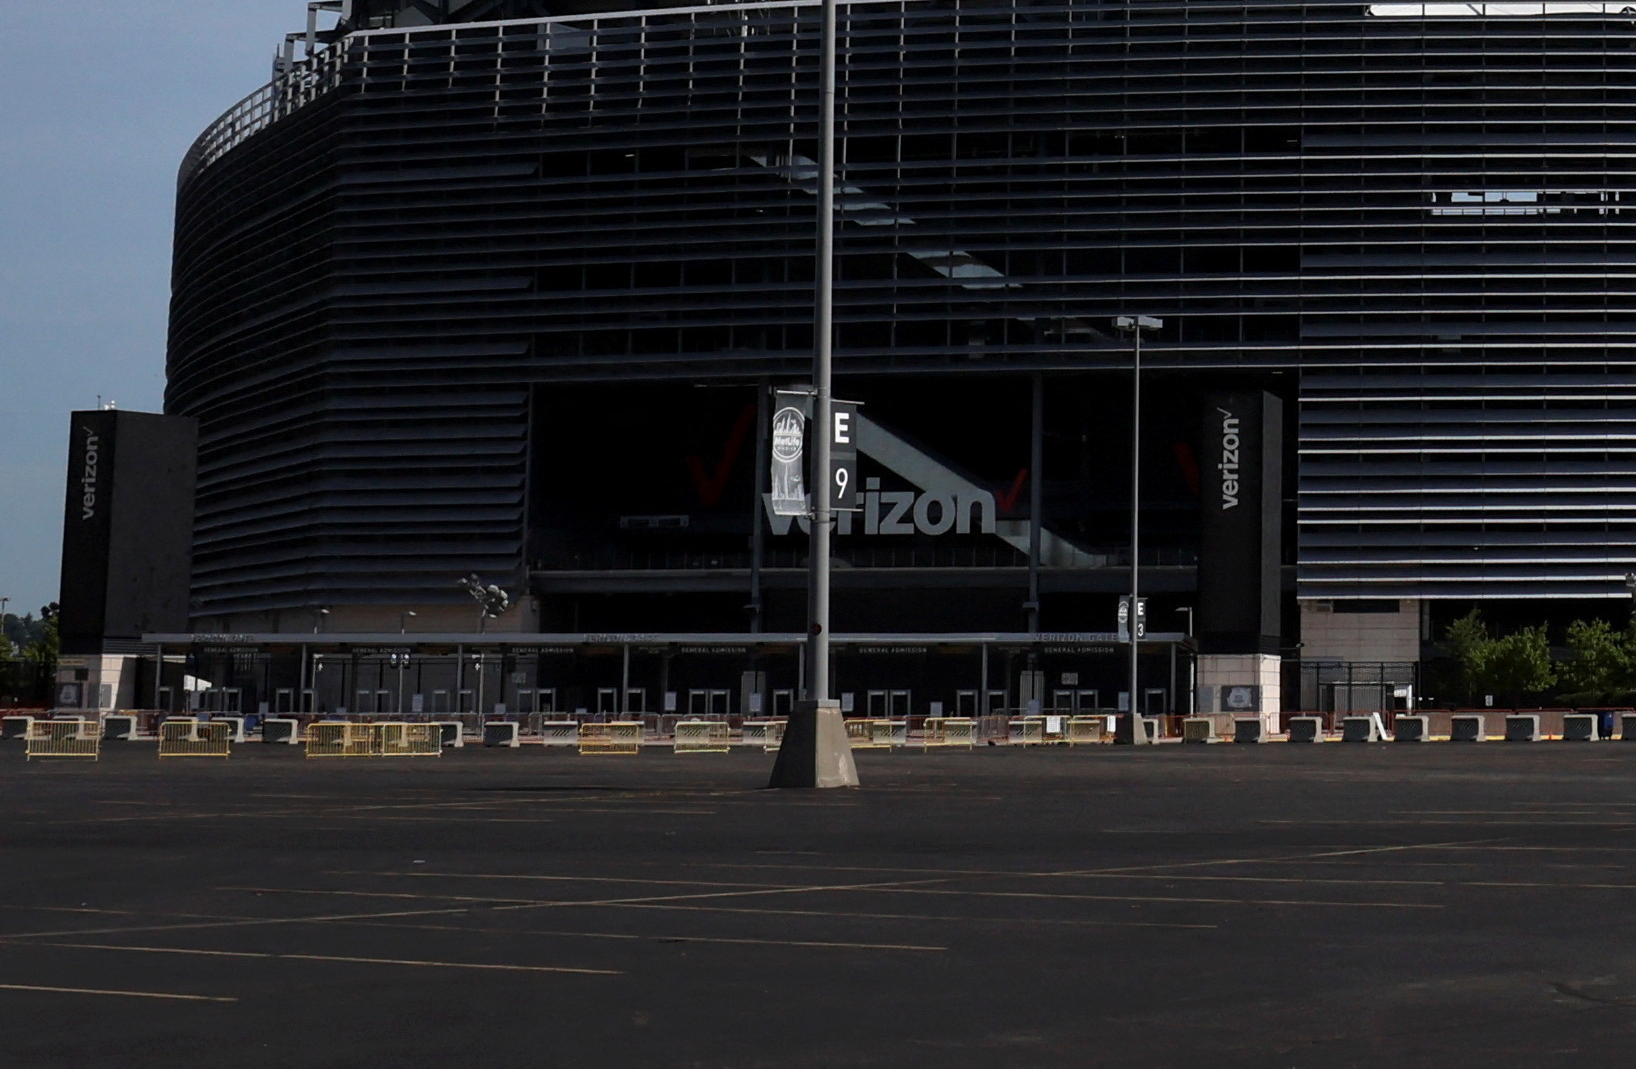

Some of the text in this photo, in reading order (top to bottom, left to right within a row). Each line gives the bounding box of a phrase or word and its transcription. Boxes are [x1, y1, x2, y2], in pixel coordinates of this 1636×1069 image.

[834, 412, 850, 444] E
[81, 435, 99, 521] verizon
[1218, 418, 1240, 510] verizon
[834, 467, 849, 499] 9
[1137, 602, 1144, 616] E
[1137, 623, 1144, 637] 3
